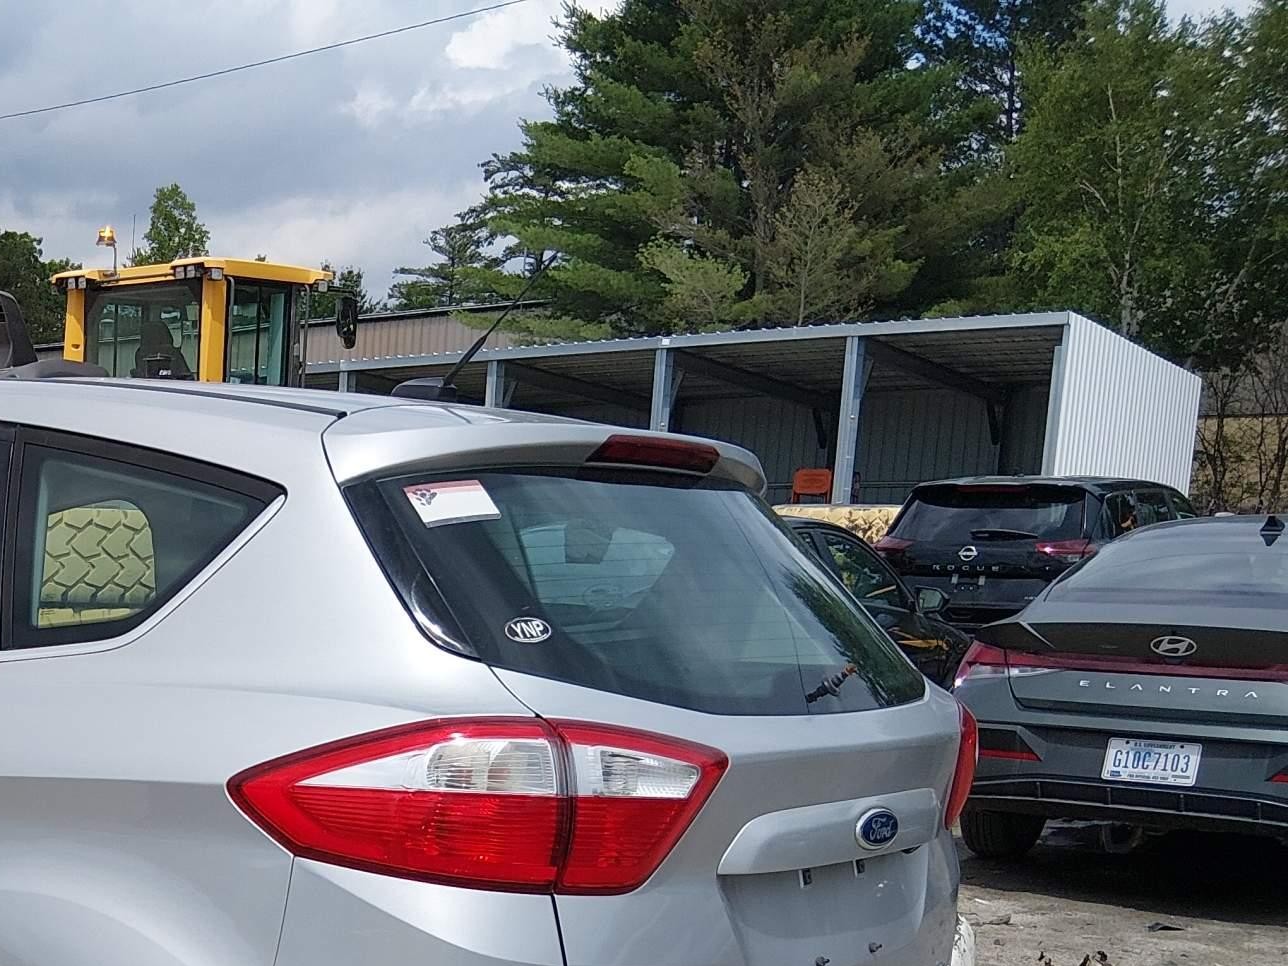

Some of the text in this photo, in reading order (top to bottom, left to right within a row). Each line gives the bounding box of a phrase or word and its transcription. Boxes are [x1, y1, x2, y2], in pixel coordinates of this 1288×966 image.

[510, 620, 544, 639] YNP
[1079, 679, 1259, 699] ELANTRA
[1112, 749, 1191, 774] G10C7103
[869, 816, 895, 841] Ford
